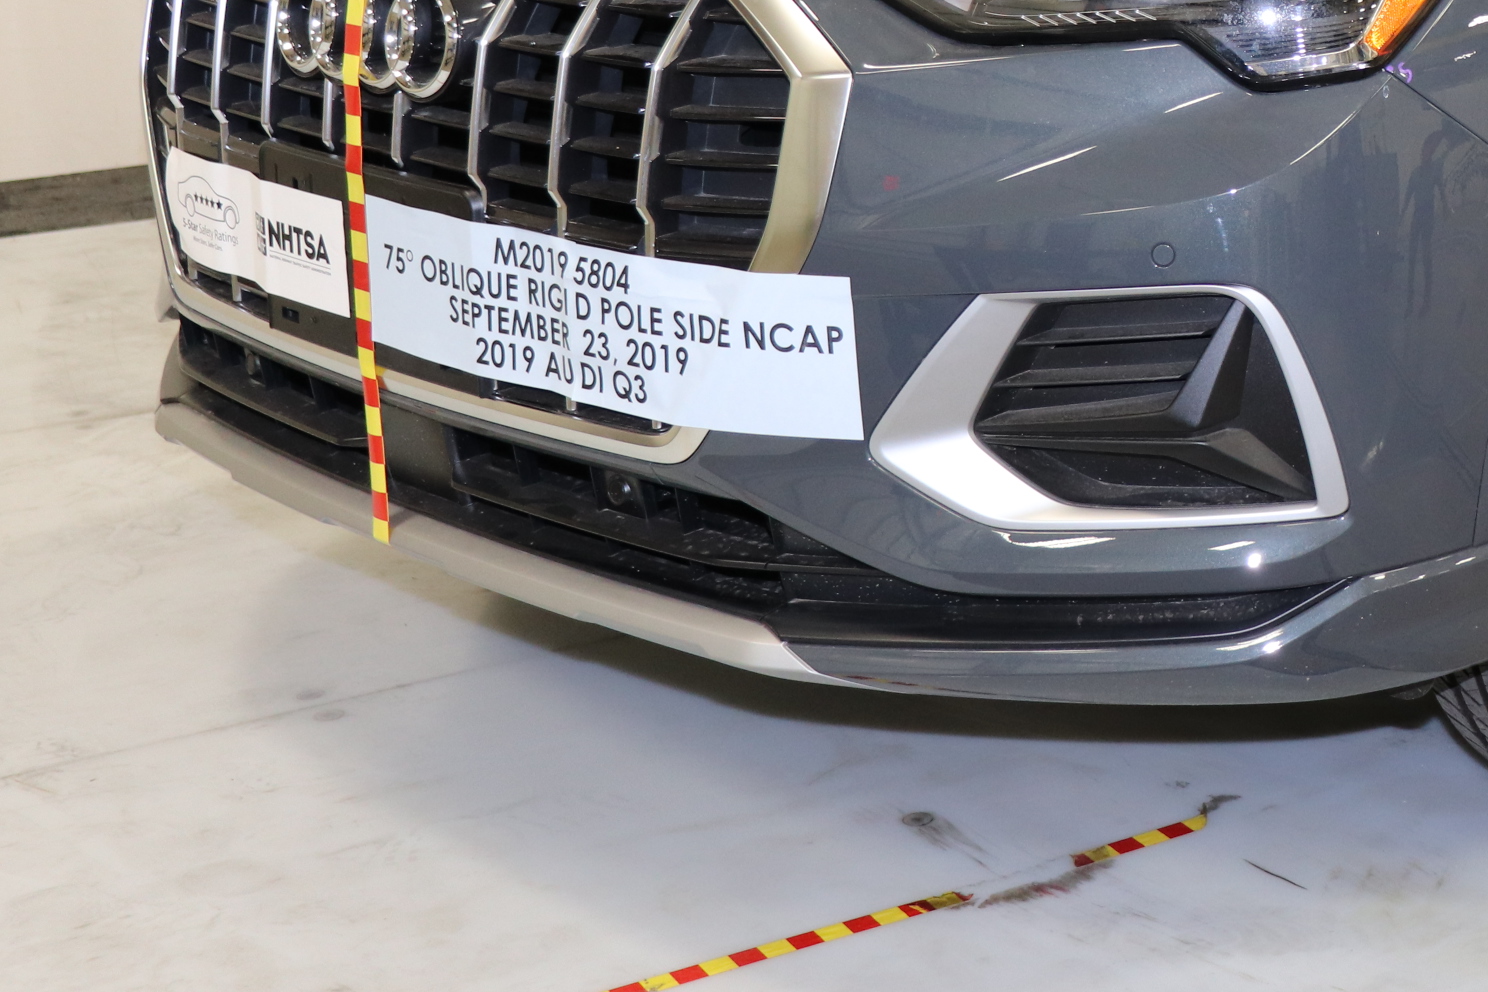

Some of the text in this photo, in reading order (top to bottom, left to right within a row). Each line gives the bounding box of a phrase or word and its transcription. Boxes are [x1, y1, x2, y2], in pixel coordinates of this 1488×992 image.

[182, 217, 239, 247] 5-Star Safety Ratings
[267, 218, 331, 265] NHTSA
[383, 243, 414, 274] 75°
[420, 254, 519, 302] OBLIQUE
[601, 296, 664, 337] POLE
[673, 310, 731, 349] SIDE
[743, 320, 844, 355] NCAP
[449, 295, 689, 376] SEPTEMBER 23, 2019
[475, 337, 535, 373] 2019
[612, 369, 648, 404] Q3
